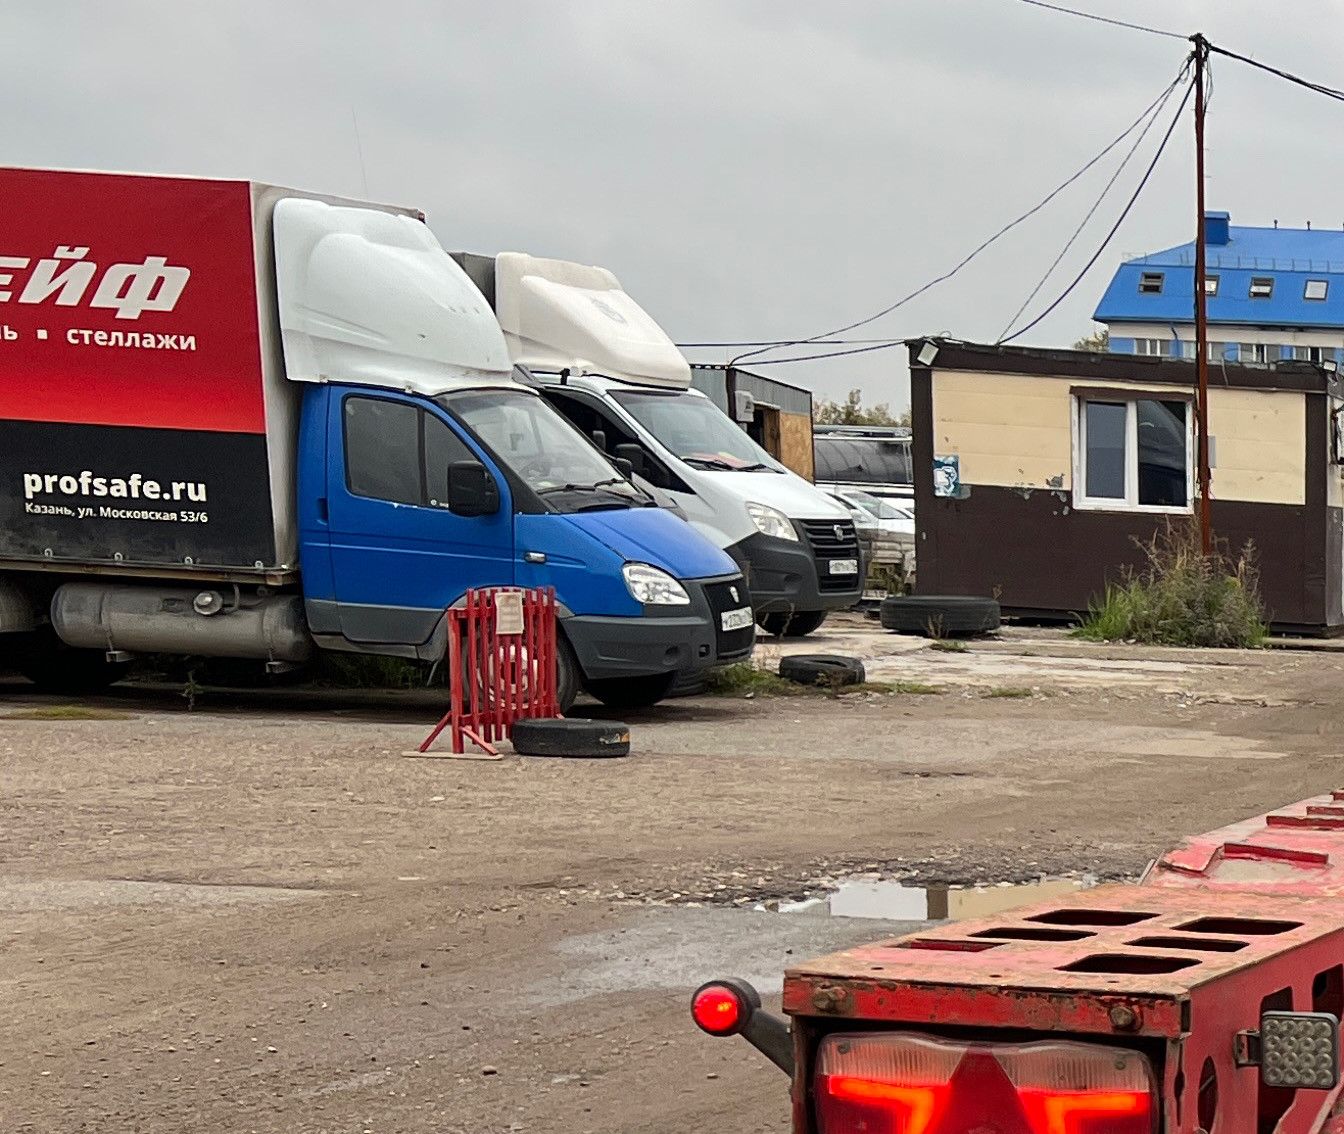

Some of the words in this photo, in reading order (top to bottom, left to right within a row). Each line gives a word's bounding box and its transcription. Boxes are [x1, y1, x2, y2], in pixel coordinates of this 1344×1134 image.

[0, 325, 18, 340] ь
[66, 328, 196, 351] стеллажи
[23, 470, 207, 502] profsafe.ru
[25, 502, 76, 517] Казань,
[78, 506, 97, 519] ул.
[99, 507, 178, 521] Московская
[180, 511, 209, 523] 53/6
